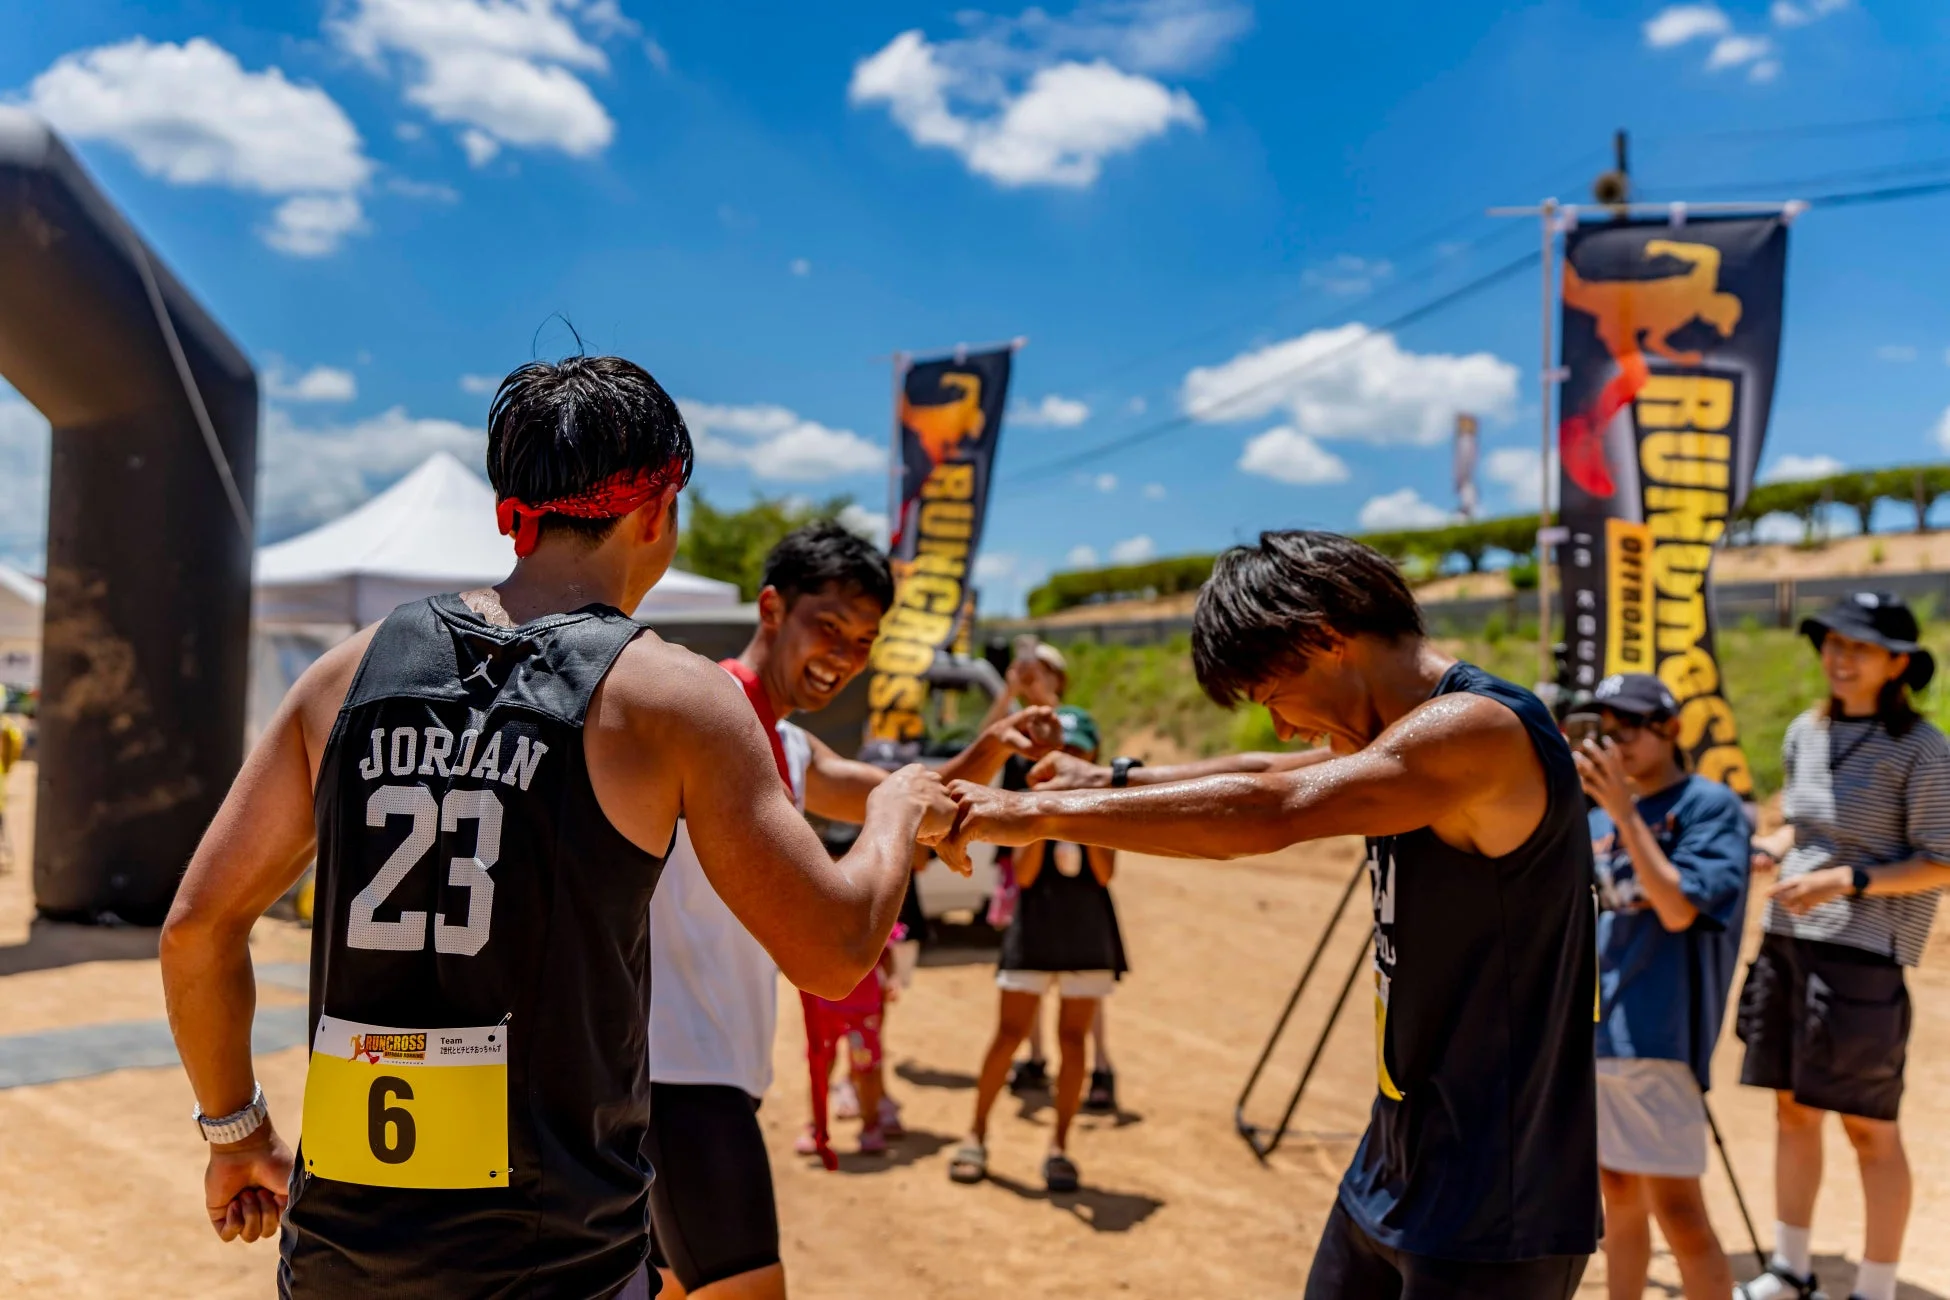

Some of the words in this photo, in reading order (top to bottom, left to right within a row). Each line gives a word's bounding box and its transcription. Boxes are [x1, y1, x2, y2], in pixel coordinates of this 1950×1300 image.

[868, 463, 975, 741] RUNCROSS
[1621, 535, 1645, 665] OFFROAD
[359, 727, 549, 790] JORDAN
[347, 785, 504, 957] 23
[365, 1034, 426, 1051] RUNCROSS
[440, 1037, 463, 1045] Team
[367, 1075, 417, 1164] 6
